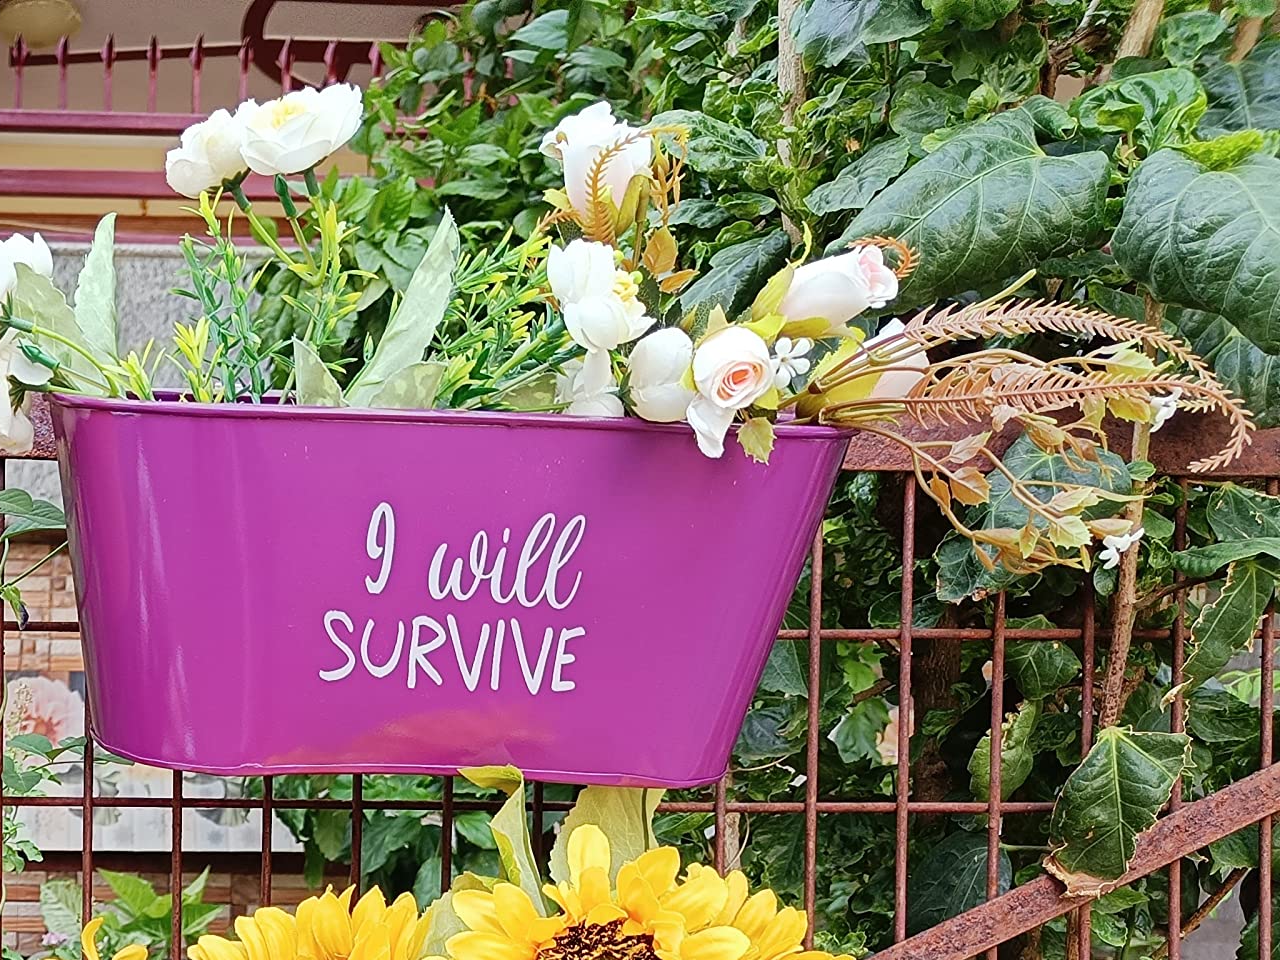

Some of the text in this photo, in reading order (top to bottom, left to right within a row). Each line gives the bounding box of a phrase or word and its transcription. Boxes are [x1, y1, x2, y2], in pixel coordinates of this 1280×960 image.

[365, 502, 586, 610] I will
[319, 610, 586, 695] SURVIVE
